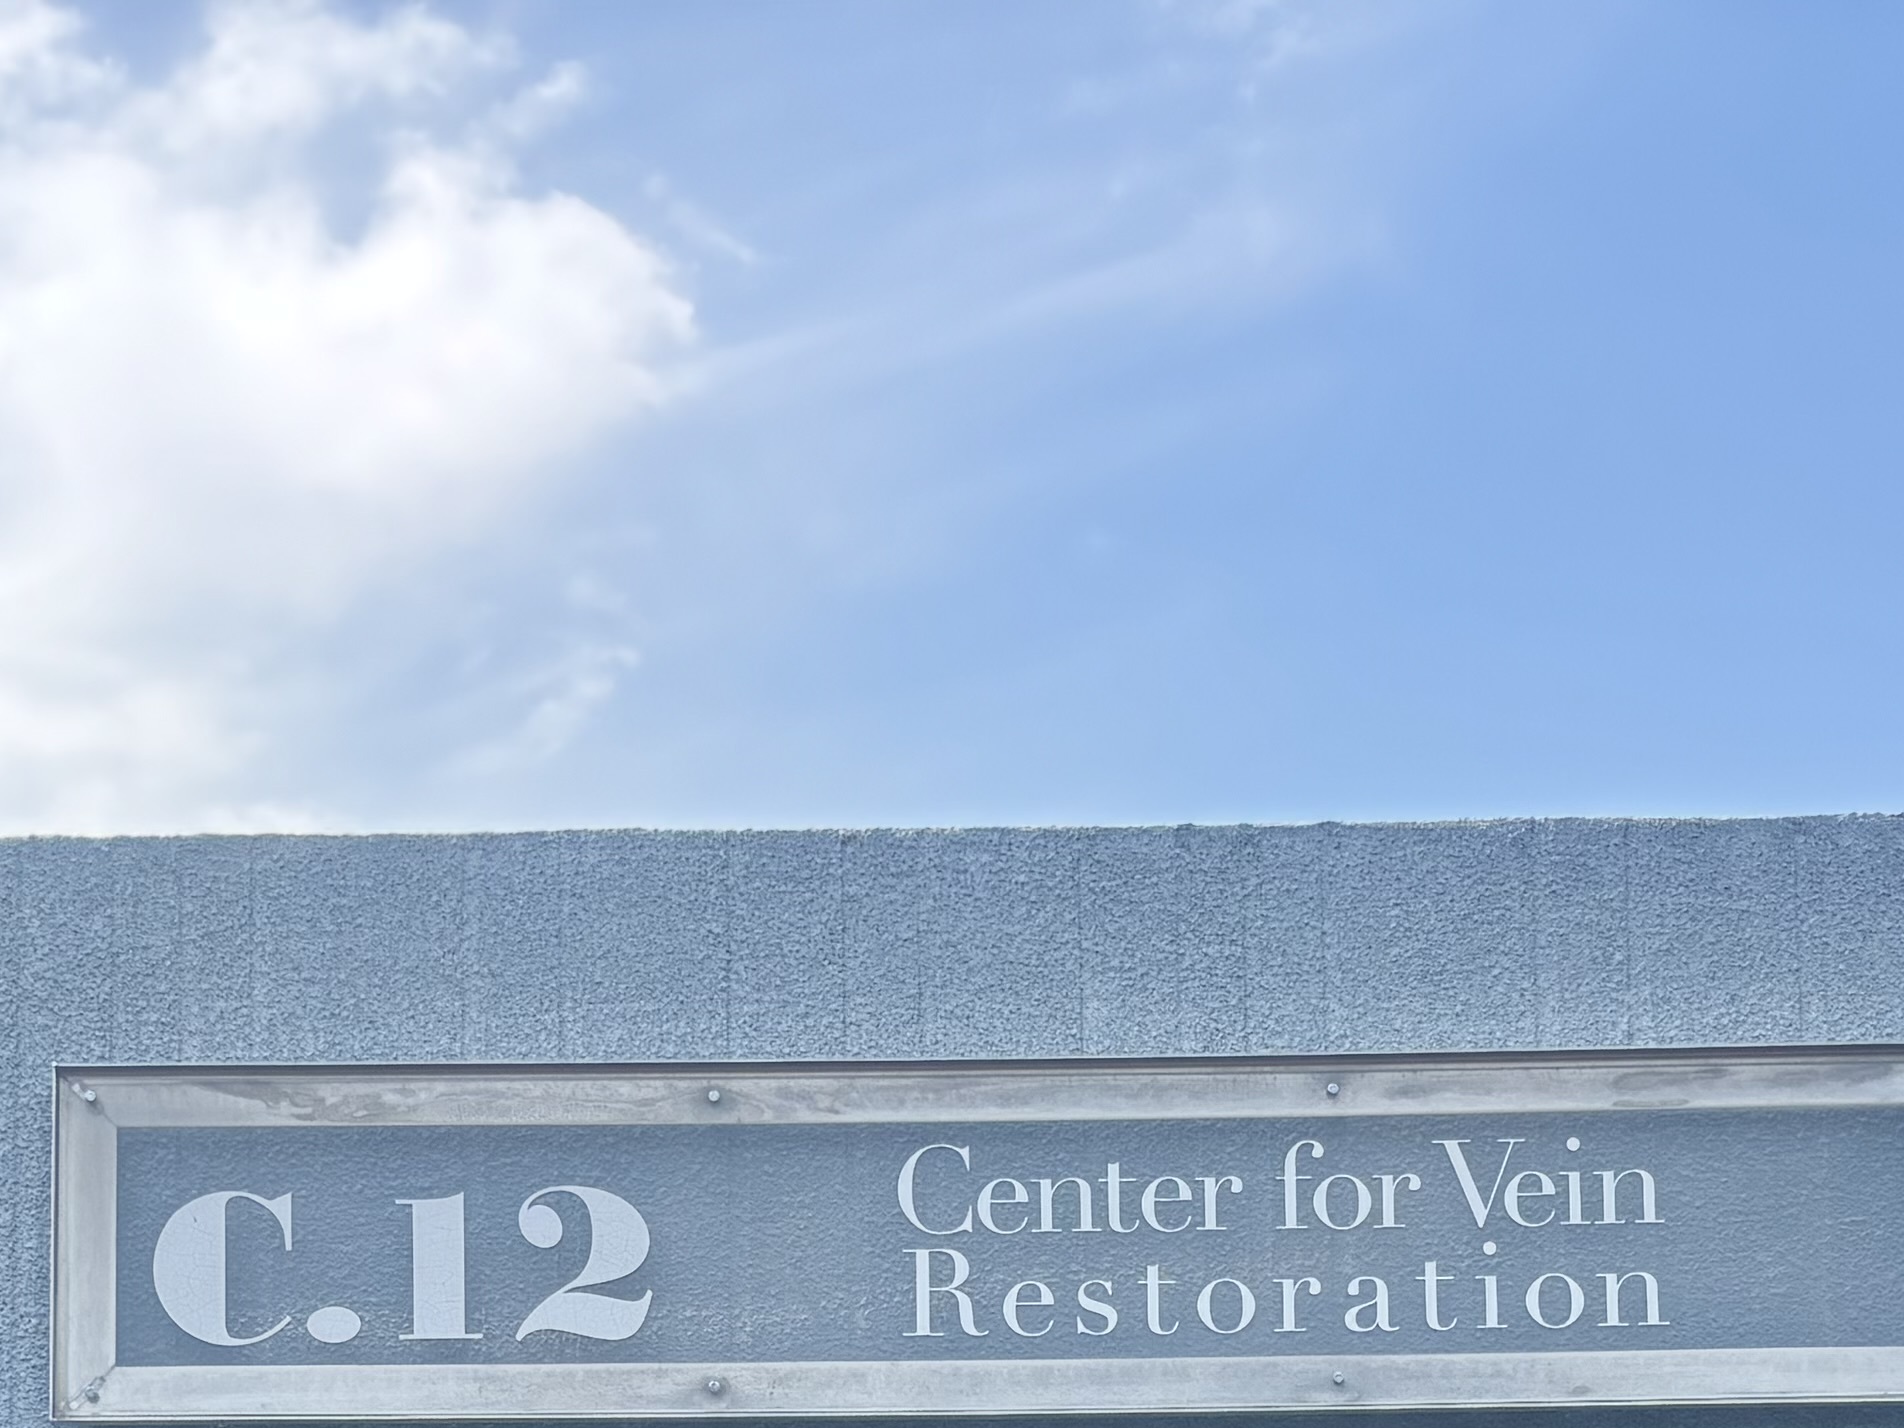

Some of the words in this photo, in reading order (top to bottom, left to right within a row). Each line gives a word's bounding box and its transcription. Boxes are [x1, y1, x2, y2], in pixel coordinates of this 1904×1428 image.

[897, 1144, 1243, 1234] Center
[1277, 1139, 1421, 1231] for
[1432, 1137, 1665, 1229] Vein
[902, 1241, 1671, 1338] Restoration
